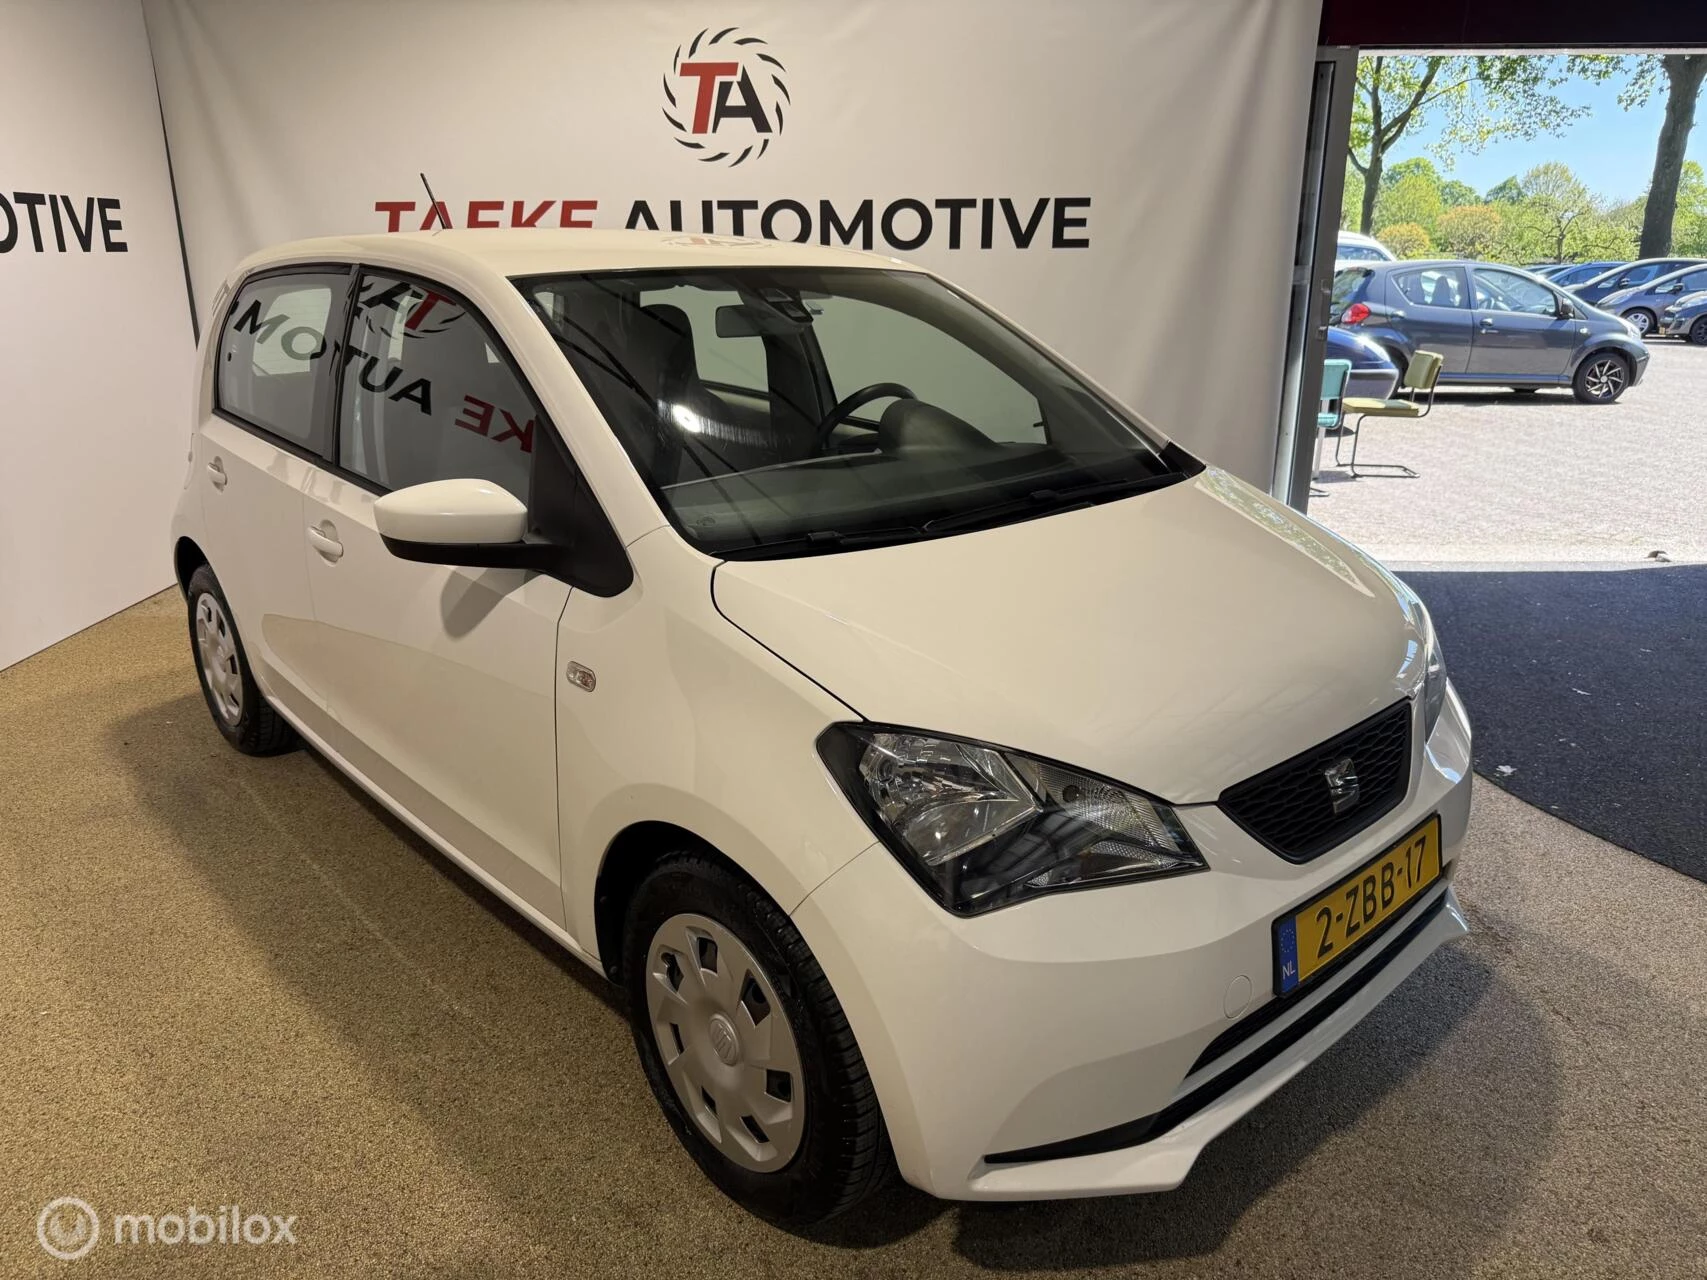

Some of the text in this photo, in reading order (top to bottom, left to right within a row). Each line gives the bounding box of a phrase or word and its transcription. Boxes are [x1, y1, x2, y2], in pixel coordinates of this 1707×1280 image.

[680, 62, 773, 134] TA
[625, 197, 1091, 251] AUTOMOTIVE
[1316, 835, 1426, 959] 2-ZBB-17
[1282, 959, 1296, 980] NL
